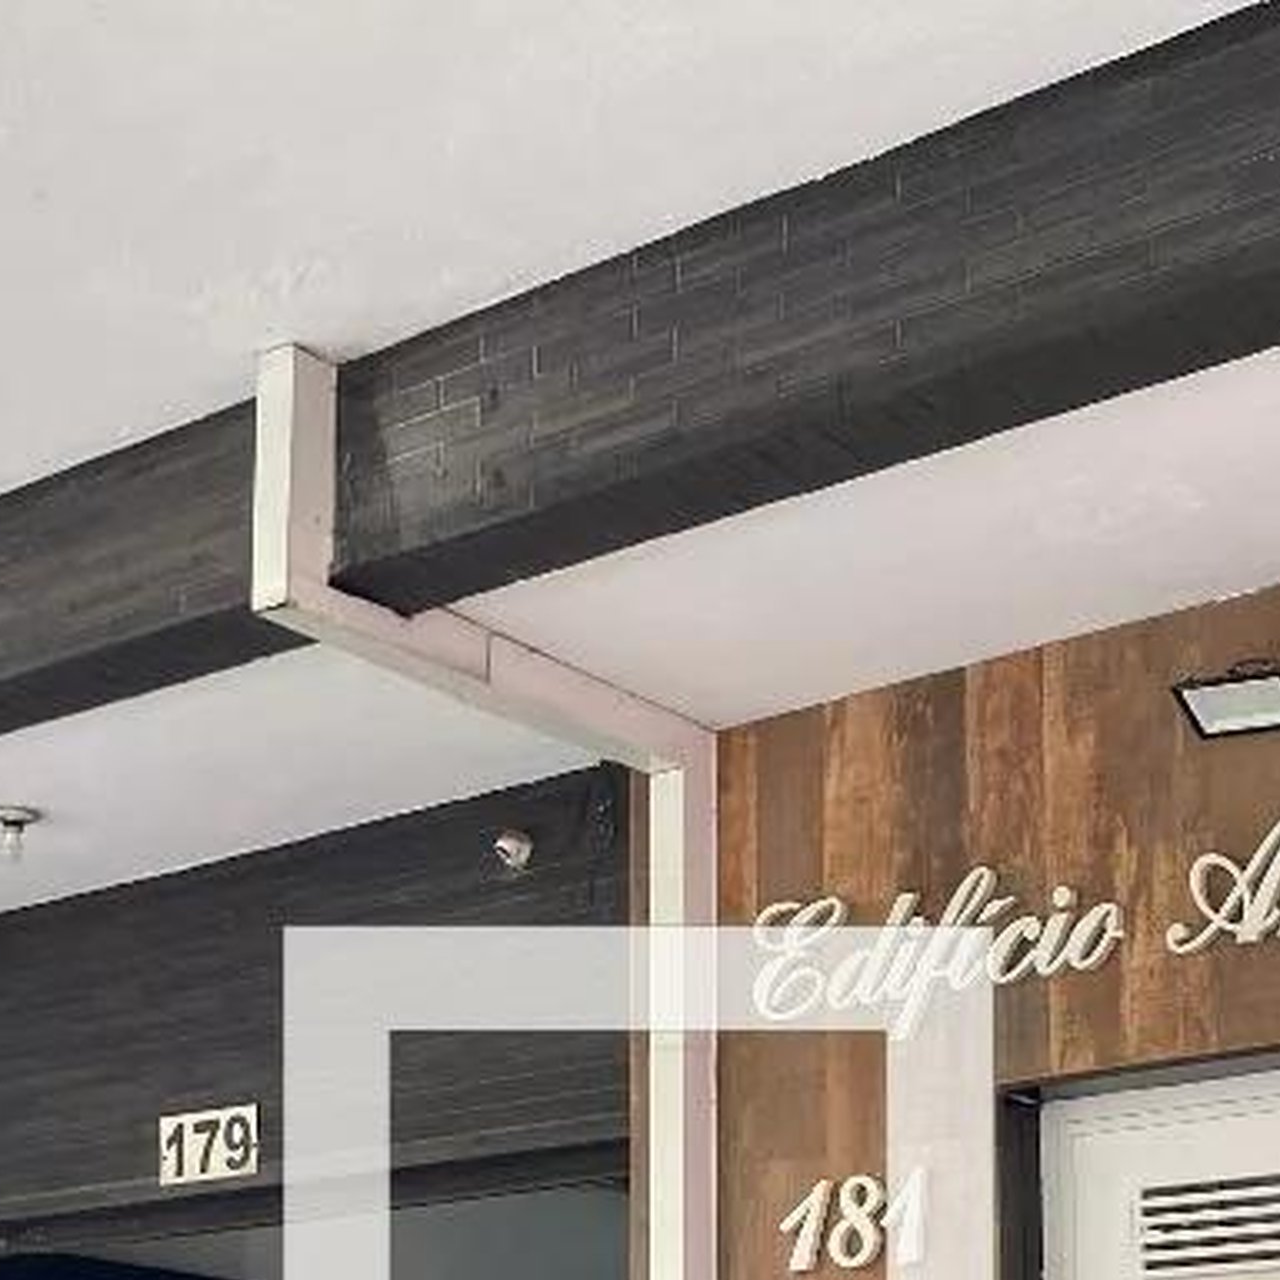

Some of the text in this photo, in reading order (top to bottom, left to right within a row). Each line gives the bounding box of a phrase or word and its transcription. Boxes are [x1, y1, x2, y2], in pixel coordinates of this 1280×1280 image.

[748, 864, 1125, 1040] Edifício
[166, 1114, 252, 1178] 179
[778, 1170, 928, 1273] 181
